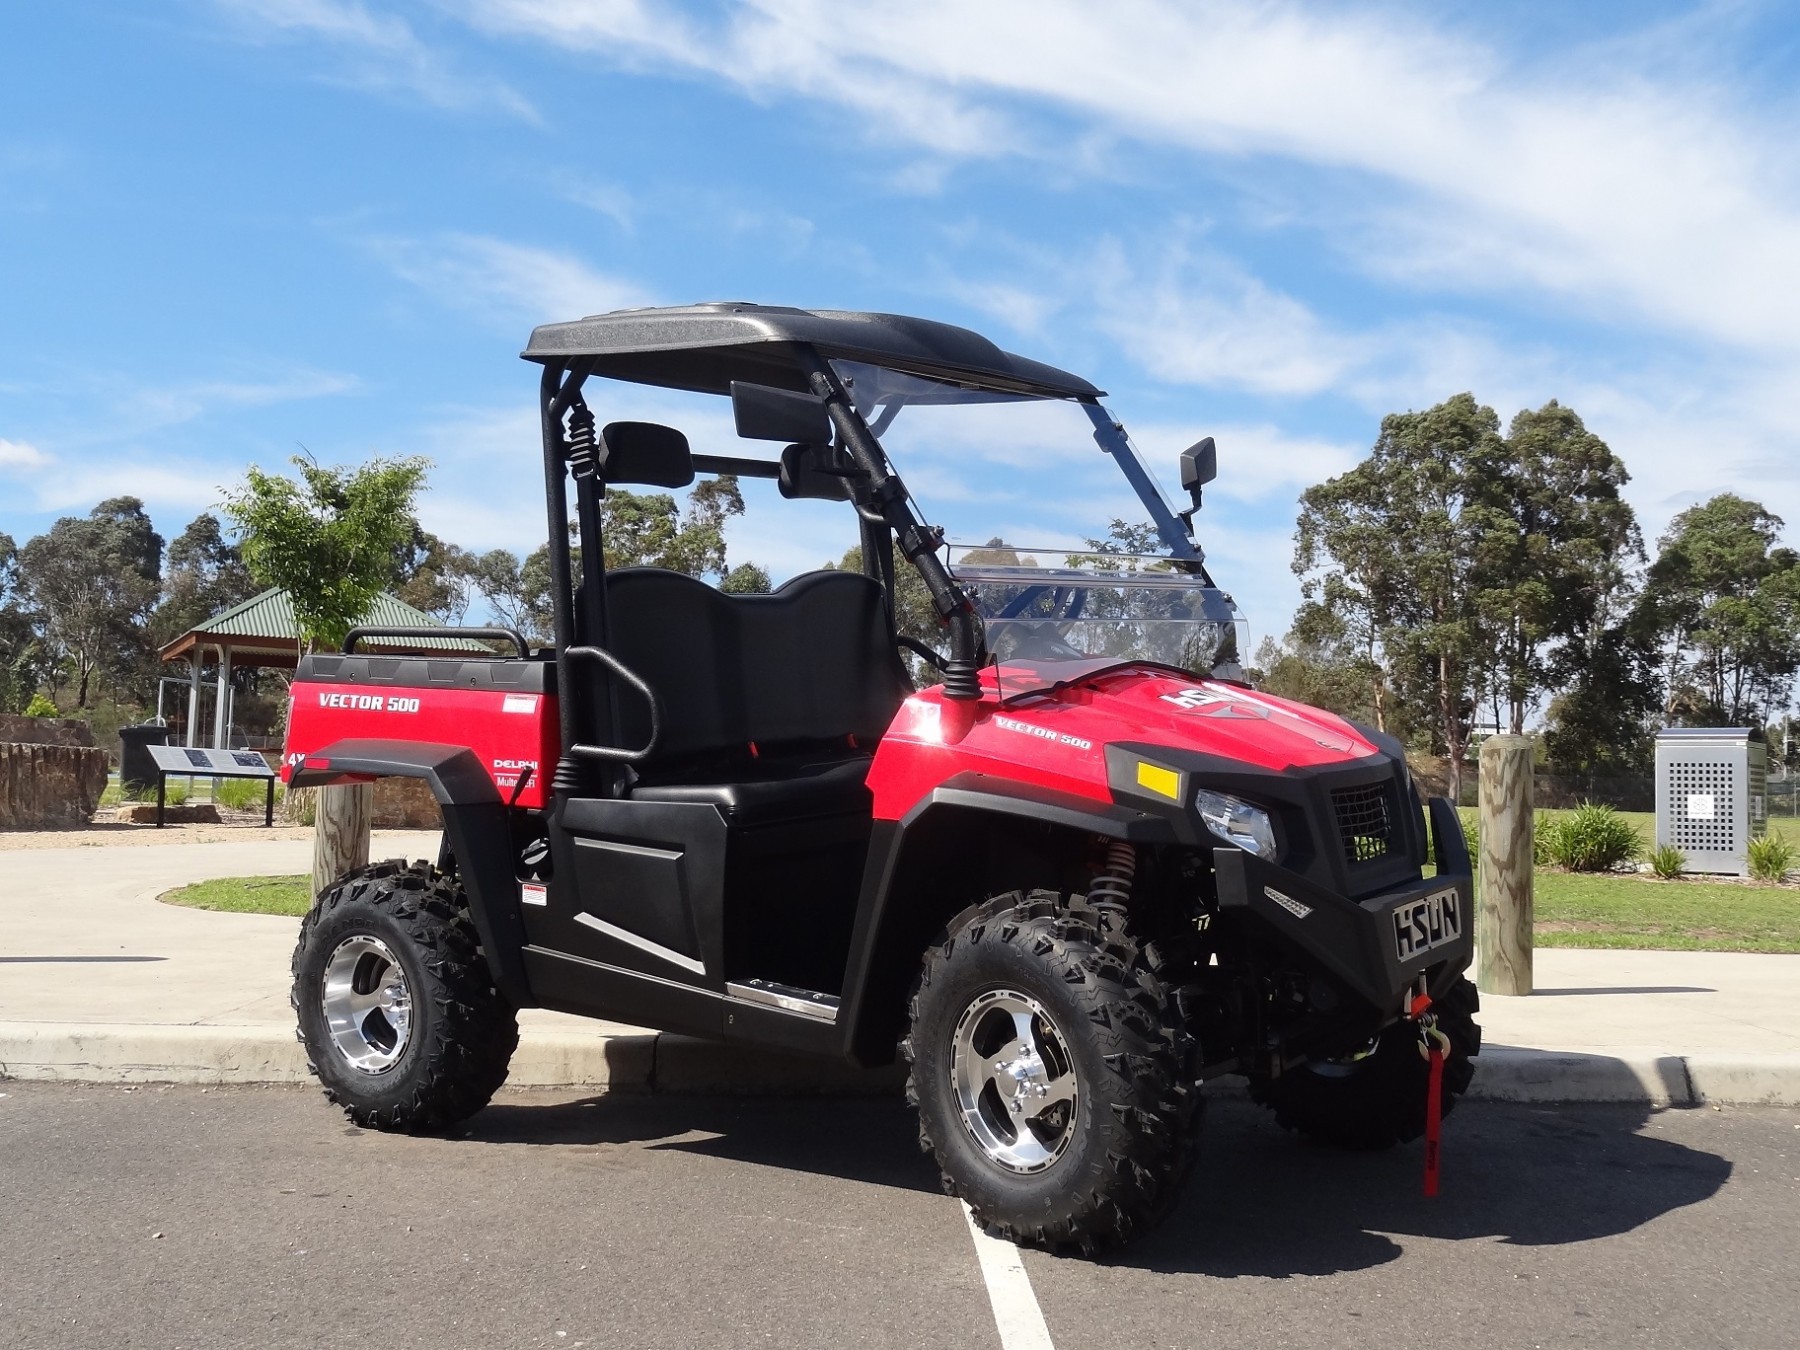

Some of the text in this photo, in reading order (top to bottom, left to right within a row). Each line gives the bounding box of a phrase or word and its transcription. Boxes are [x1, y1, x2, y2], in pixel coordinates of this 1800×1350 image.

[319, 692, 420, 713] VECTOR 500
[994, 715, 1092, 750] VECTOR 500
[493, 759, 538, 770] DELPHI
[497, 776, 519, 787] Multe
[1394, 893, 1459, 957] HSUN
